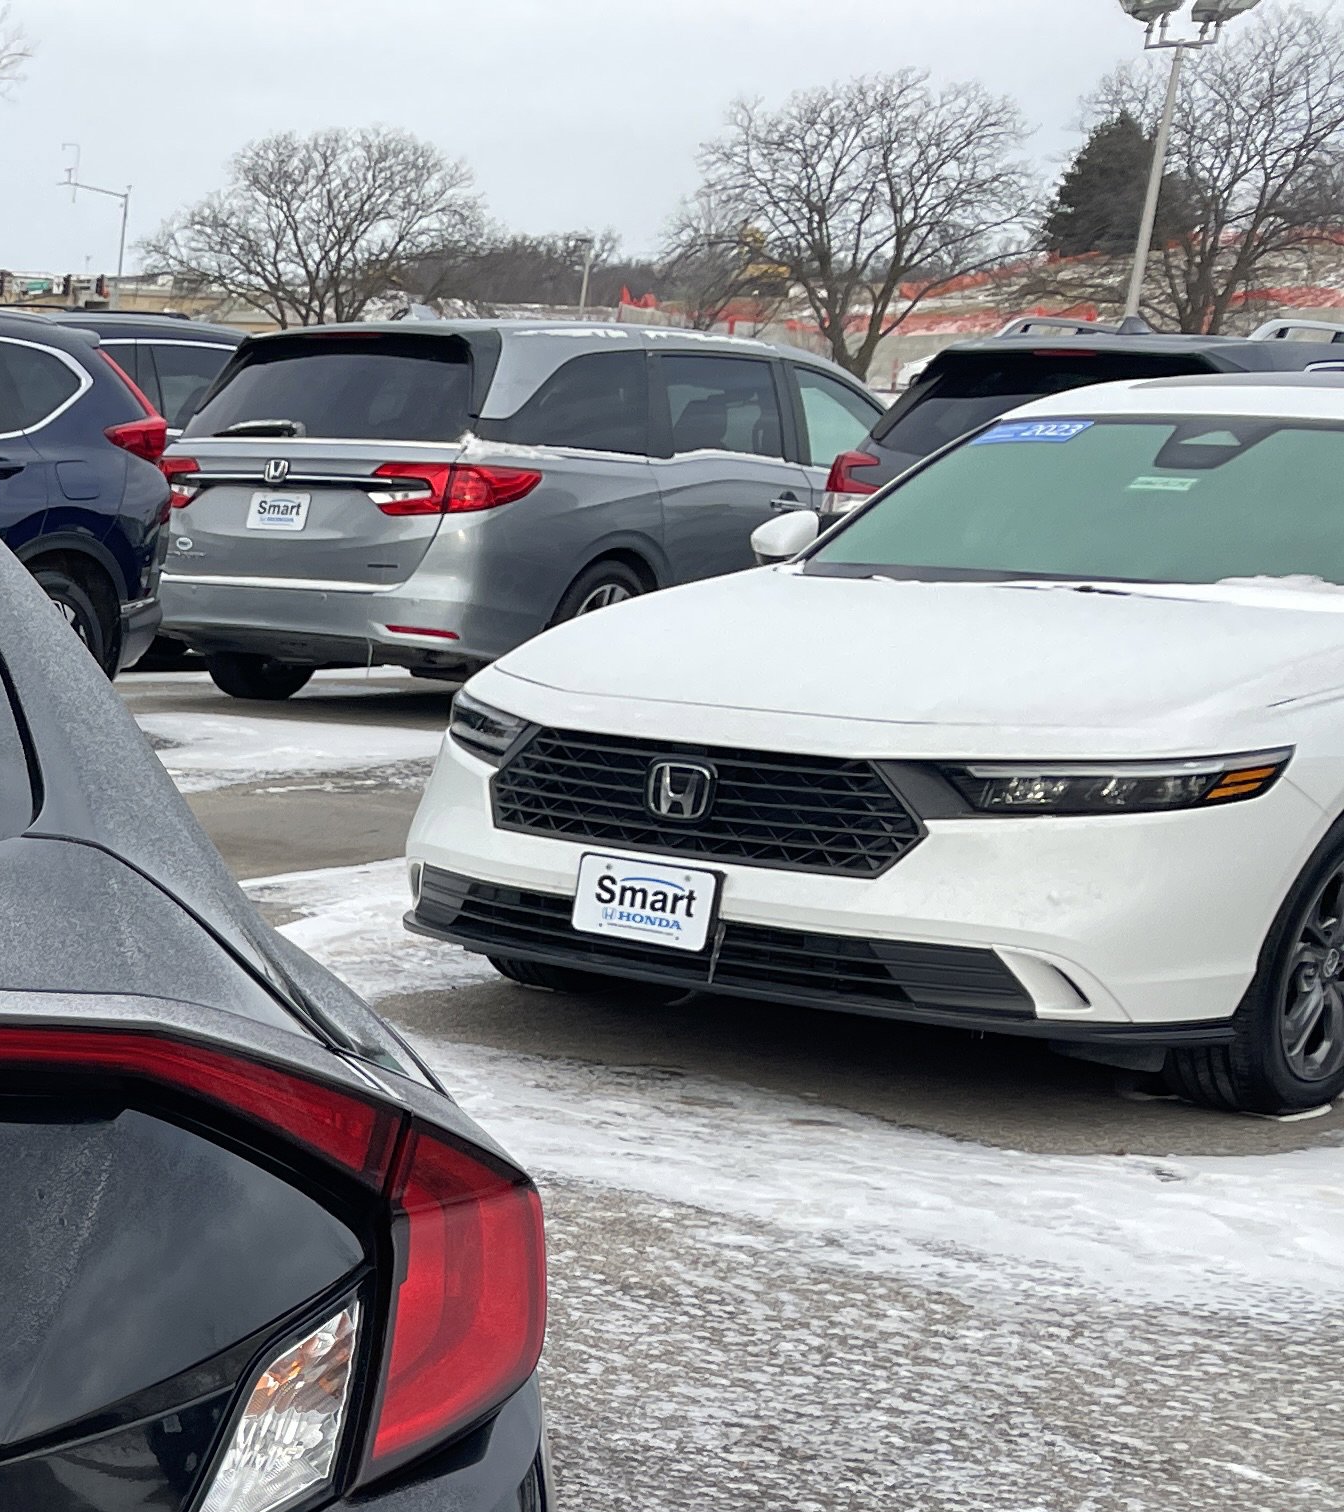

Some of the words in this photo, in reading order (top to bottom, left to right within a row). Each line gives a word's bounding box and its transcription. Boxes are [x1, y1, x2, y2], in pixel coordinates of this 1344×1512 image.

[257, 500, 302, 516] Smart
[595, 874, 697, 918] Smart
[618, 910, 683, 931] HONDA
